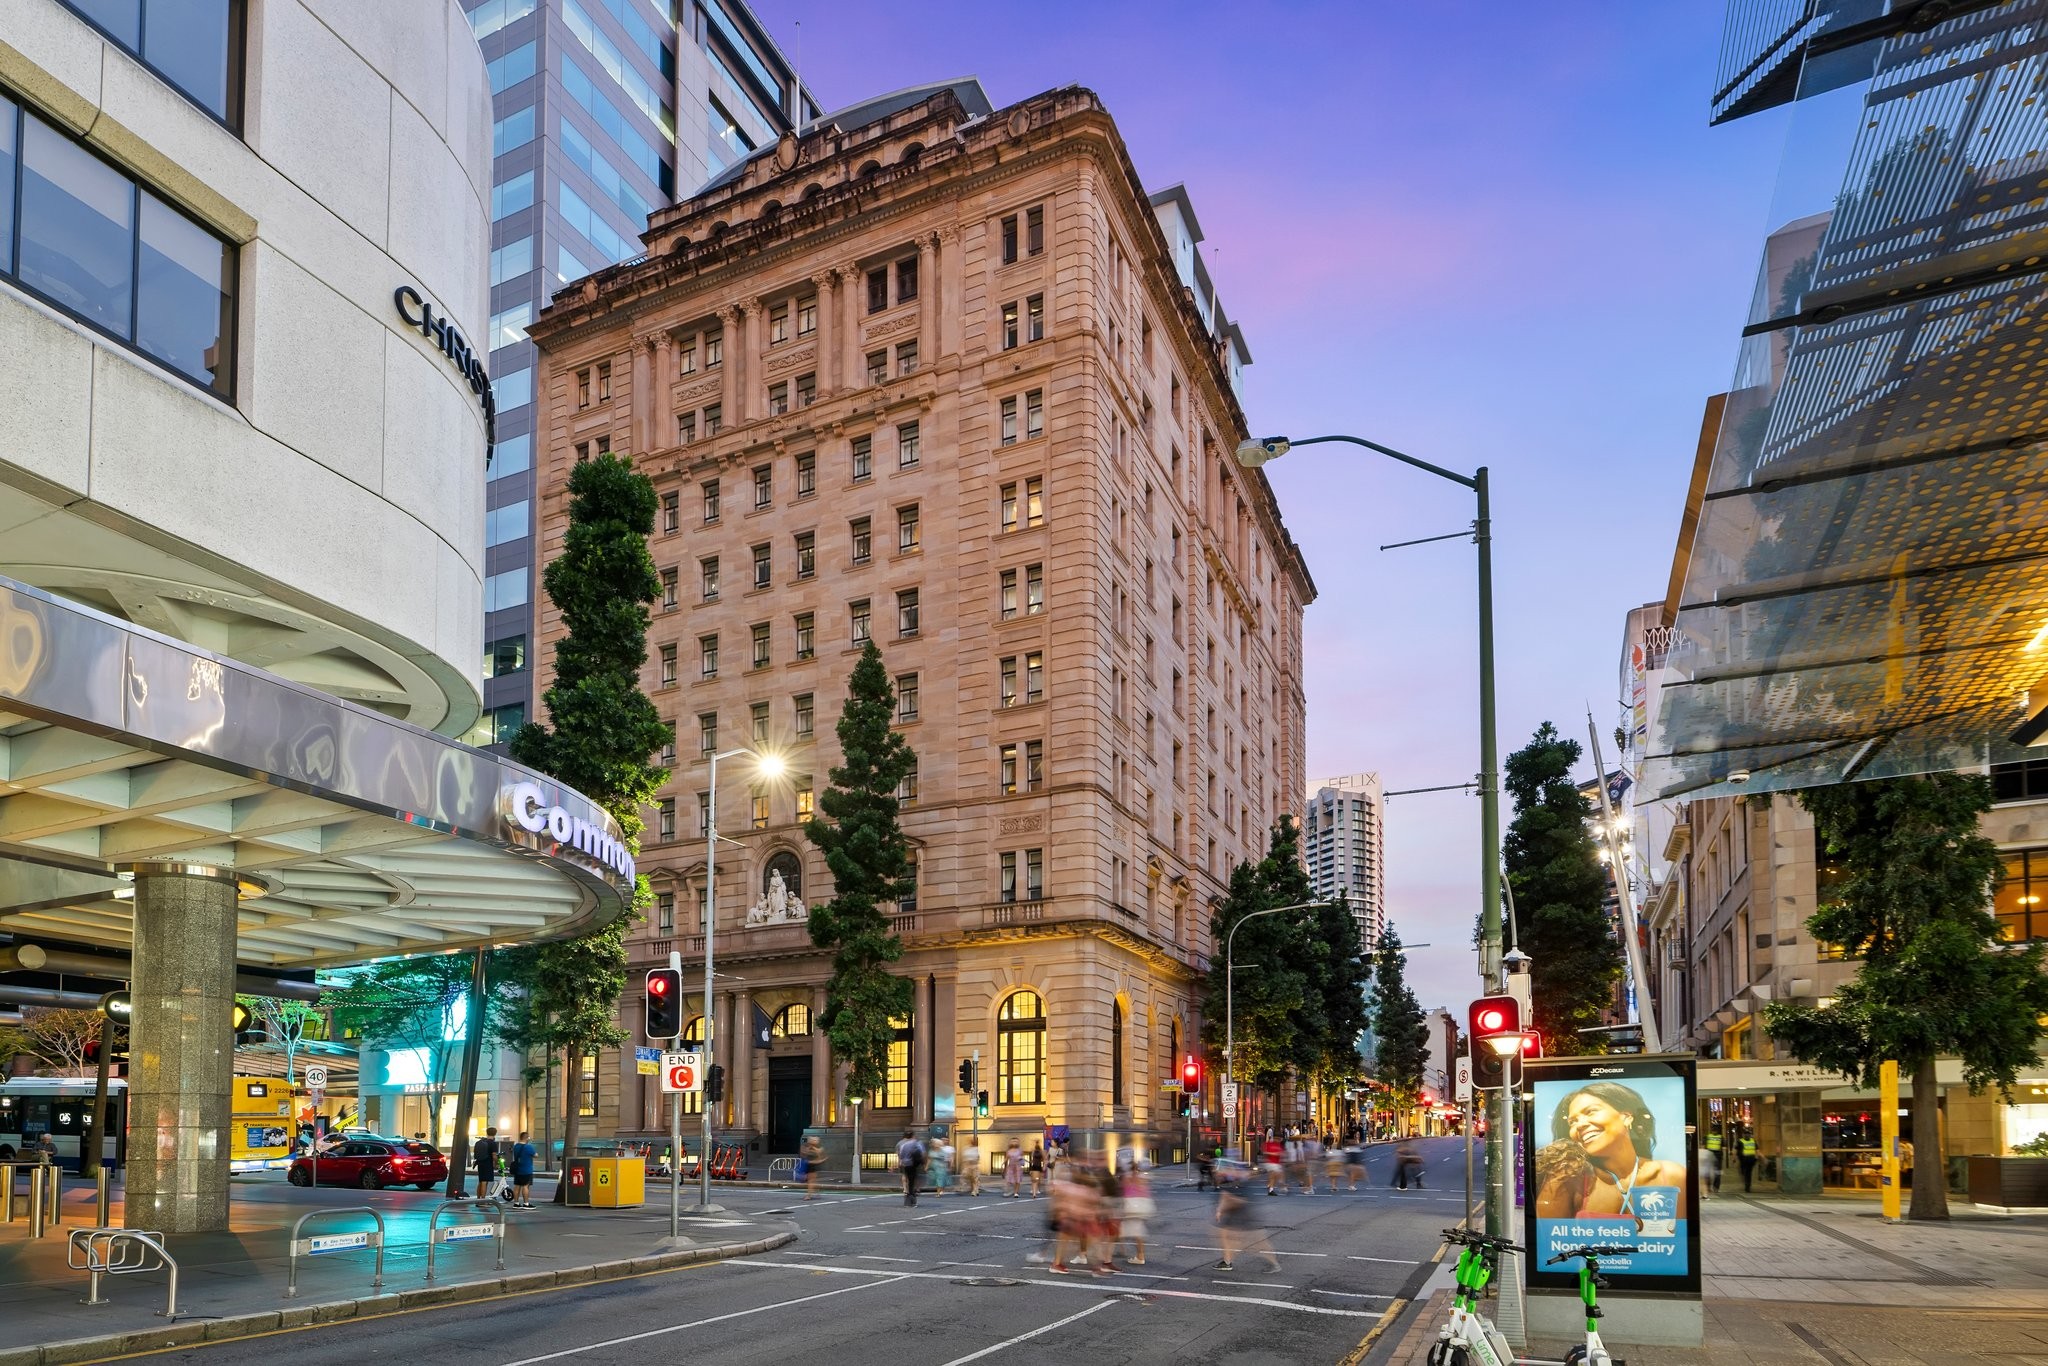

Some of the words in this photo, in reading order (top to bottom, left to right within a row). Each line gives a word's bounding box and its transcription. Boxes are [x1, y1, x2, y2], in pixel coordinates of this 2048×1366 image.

[1328, 772, 1377, 788] FELIX
[669, 1056, 695, 1065] END
[309, 1072, 324, 1081] 40
[675, 1068, 688, 1086] C
[1551, 1225, 1568, 1237] All
[1571, 1226, 1594, 1237] the
[1598, 1225, 1631, 1237] feels
[1637, 1241, 1676, 1256] dairy
[1596, 1258, 1632, 1266] ocobella
